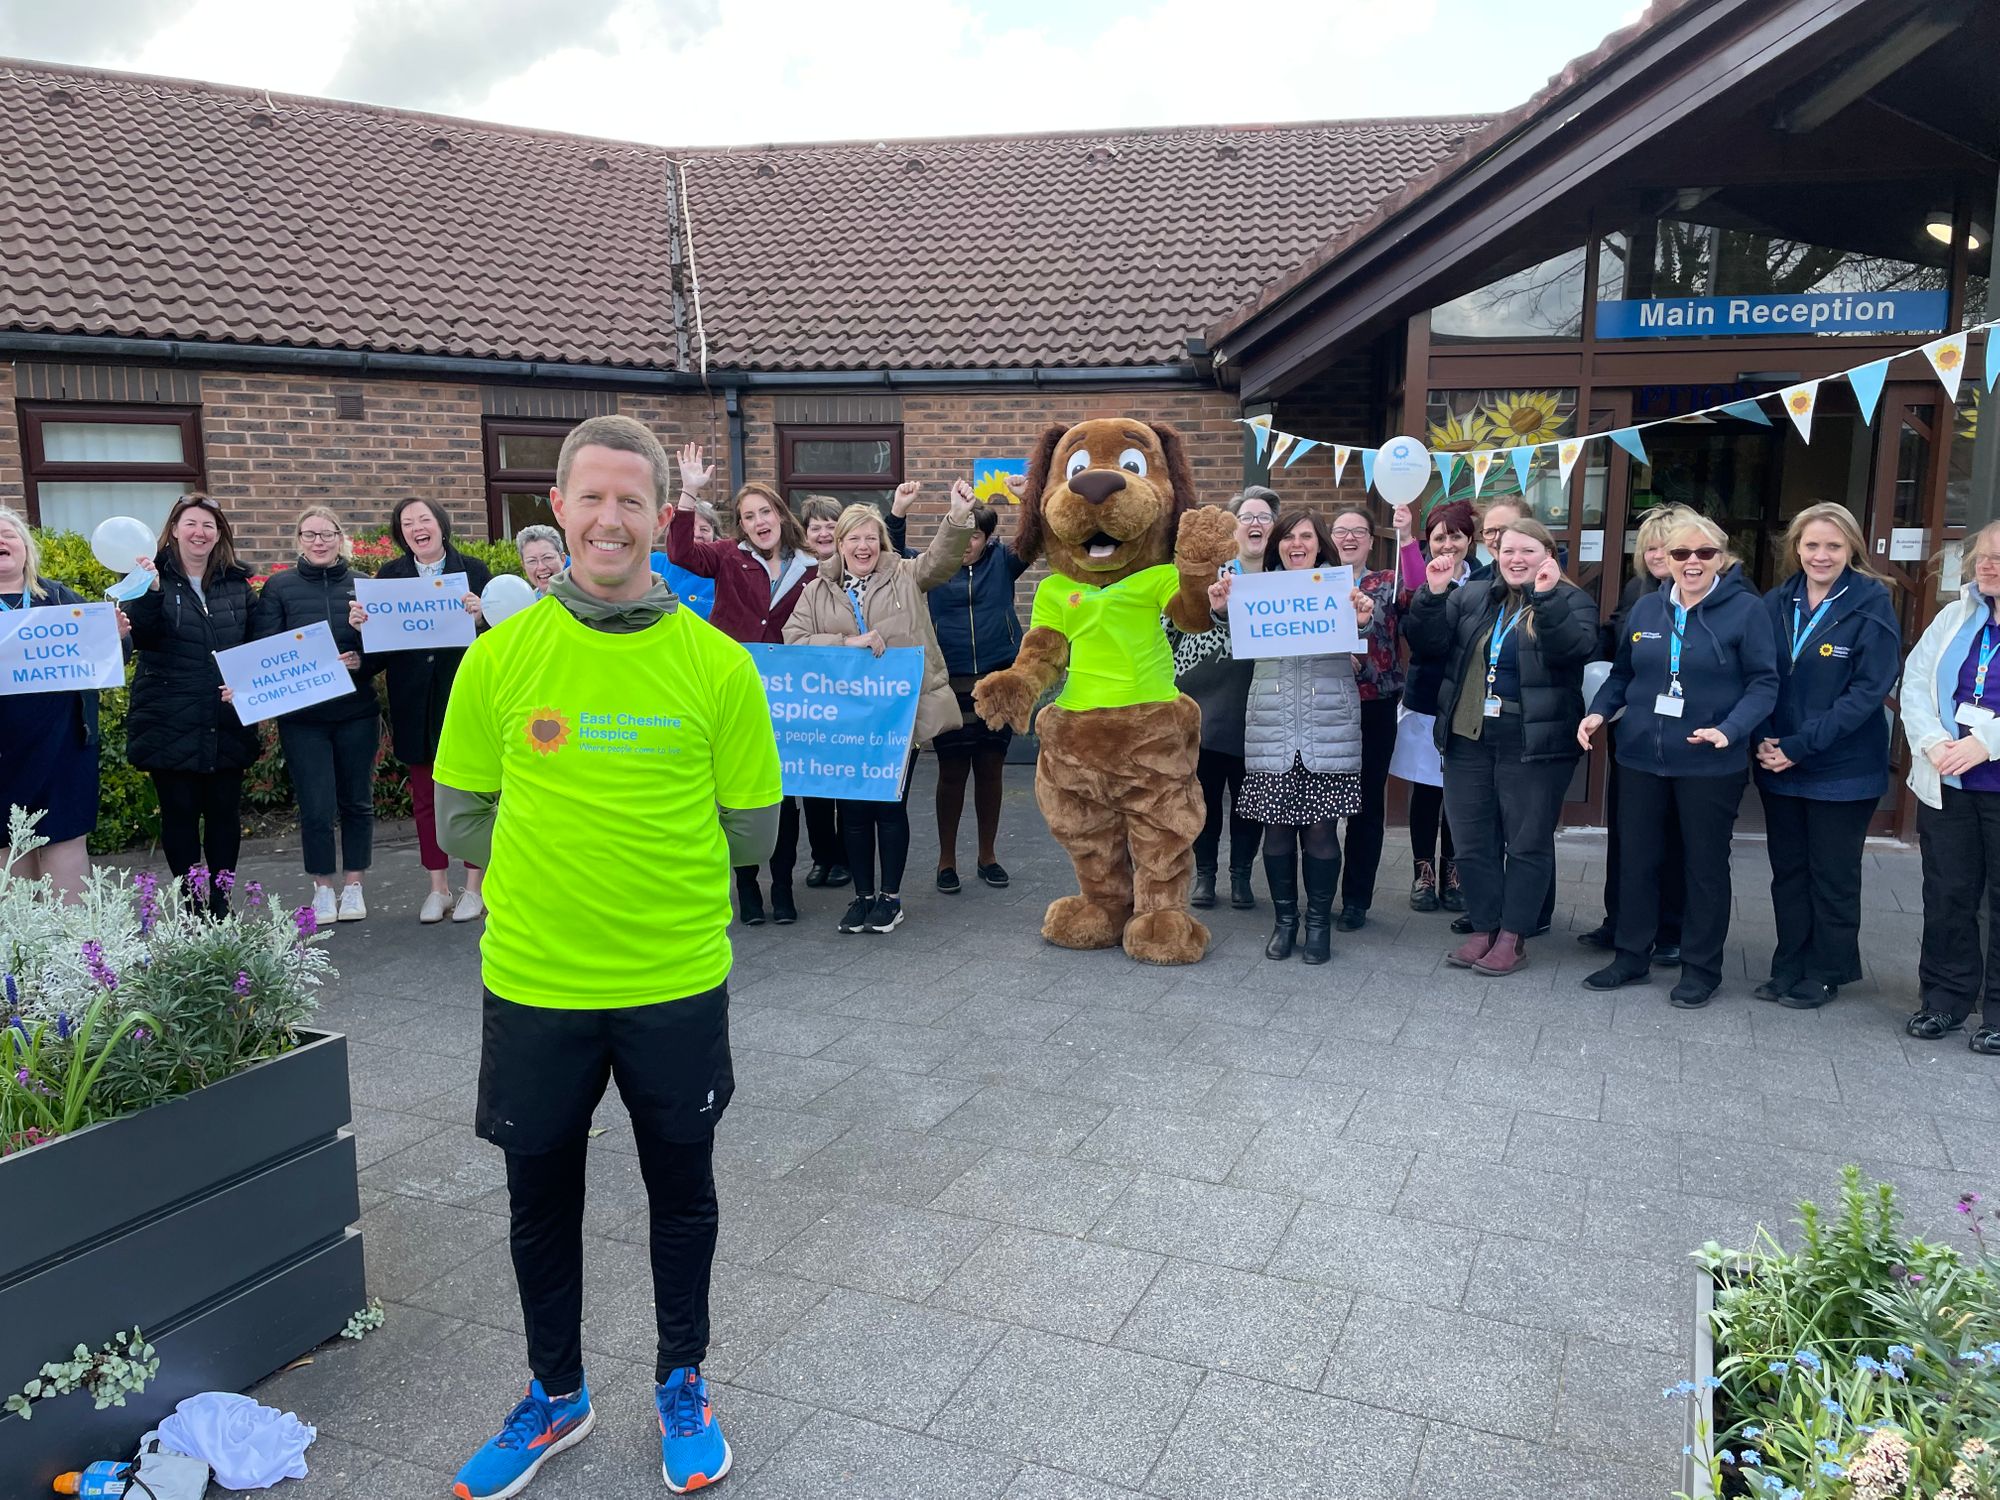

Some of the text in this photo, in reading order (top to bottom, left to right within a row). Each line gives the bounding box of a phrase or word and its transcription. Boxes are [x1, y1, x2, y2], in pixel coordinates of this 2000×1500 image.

[1639, 297, 1896, 328] Main Reception
[366, 598, 465, 614] GO MARTIN
[1324, 596, 1338, 611] A
[18, 622, 79, 640] GOOD
[402, 619, 435, 632] GO!
[1250, 618, 1336, 638] LEGEND!
[24, 643, 80, 660] LUCK
[260, 649, 300, 669] OVER
[12, 663, 96, 682] MARTIN!
[252, 660, 318, 689] HALFWAY
[247, 671, 337, 706] COMPLETED!
[801, 672, 911, 697] Cheshire
[771, 698, 839, 723] spice
[580, 712, 682, 729] East Cheshire
[579, 726, 638, 741] Hospice
[786, 728, 827, 746] people
[831, 733, 865, 746] come
[870, 731, 884, 746] to
[888, 730, 908, 746] live
[607, 744, 632, 754] people
[657, 745, 666, 754] to
[810, 758, 856, 777] here
